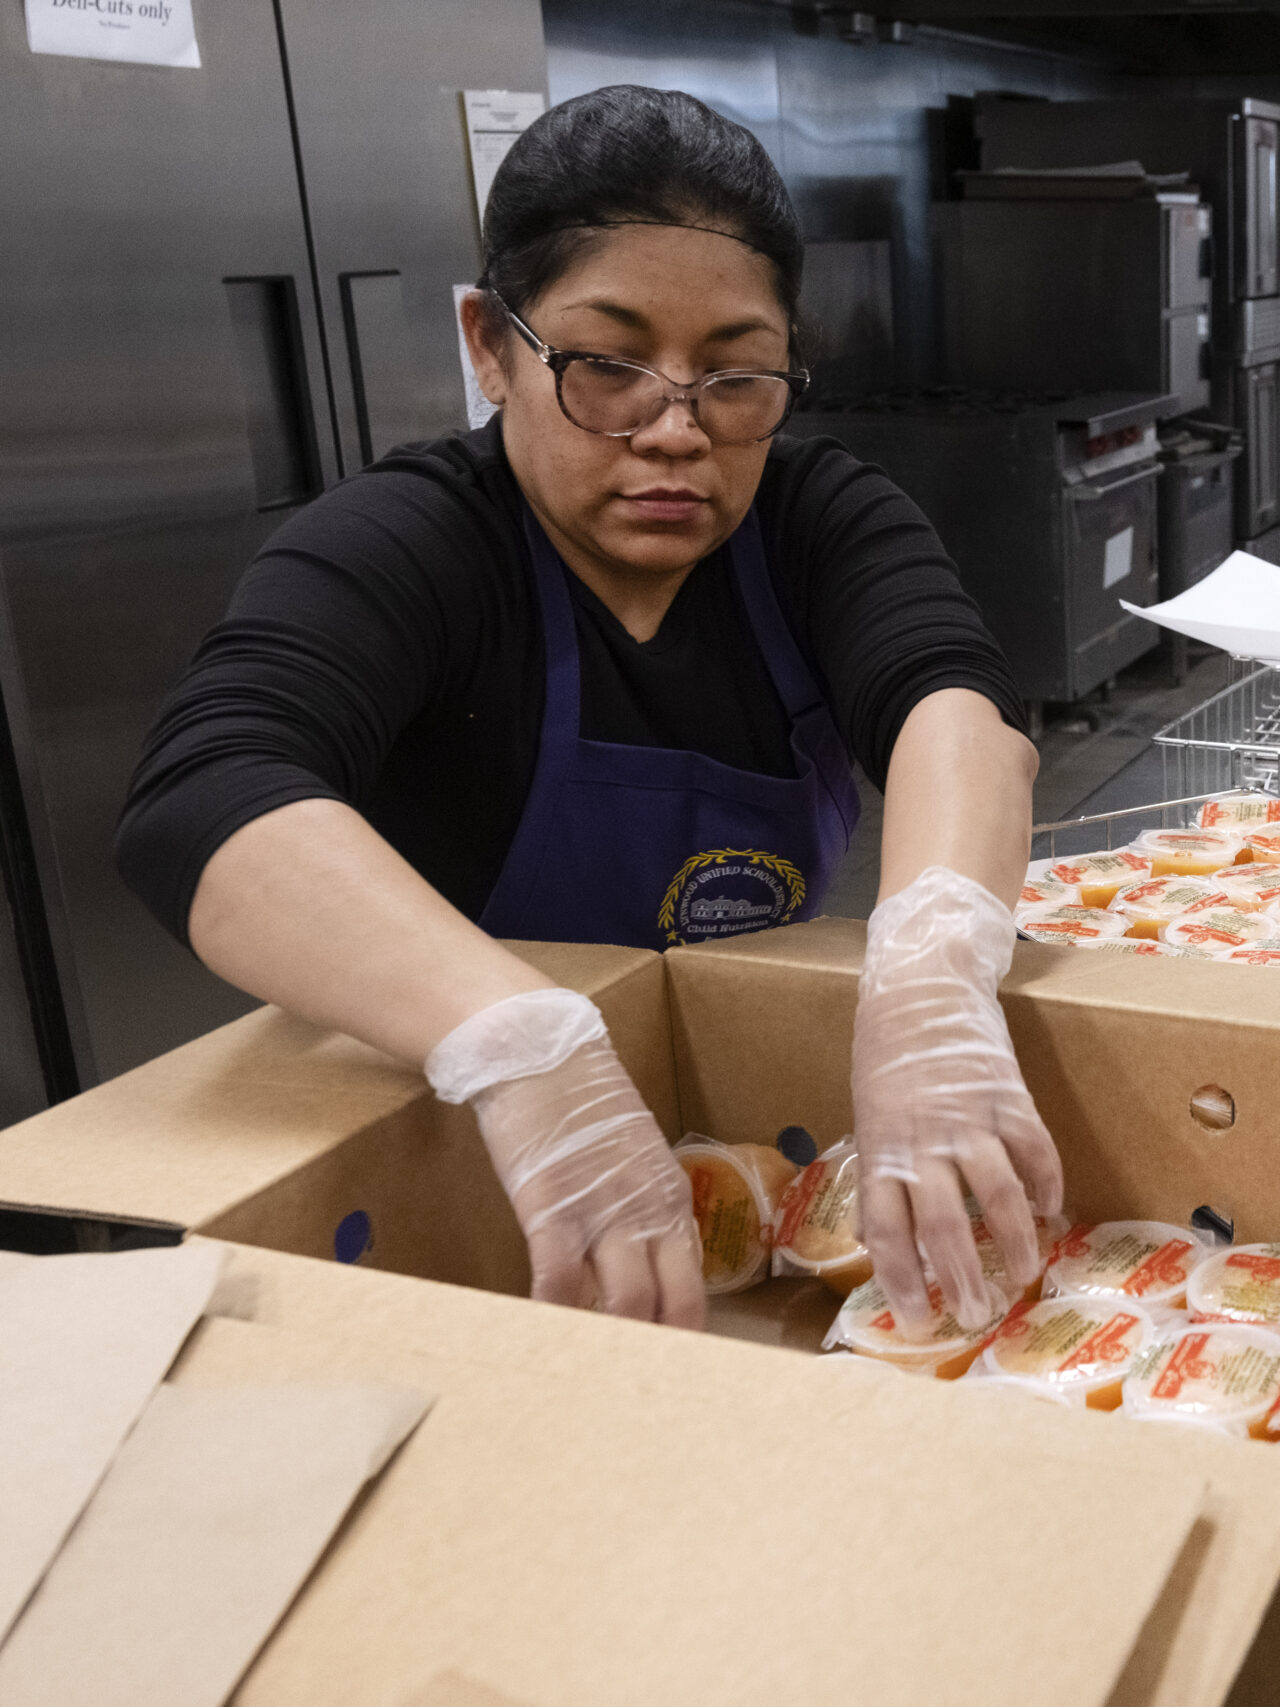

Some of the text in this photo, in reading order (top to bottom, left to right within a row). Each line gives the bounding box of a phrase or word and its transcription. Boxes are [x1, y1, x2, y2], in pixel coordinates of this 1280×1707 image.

[138, 0, 172, 27] only
[696, 866, 741, 884] UNIFIED
[742, 866, 778, 889] SCHOOL
[686, 924, 718, 934] Child
